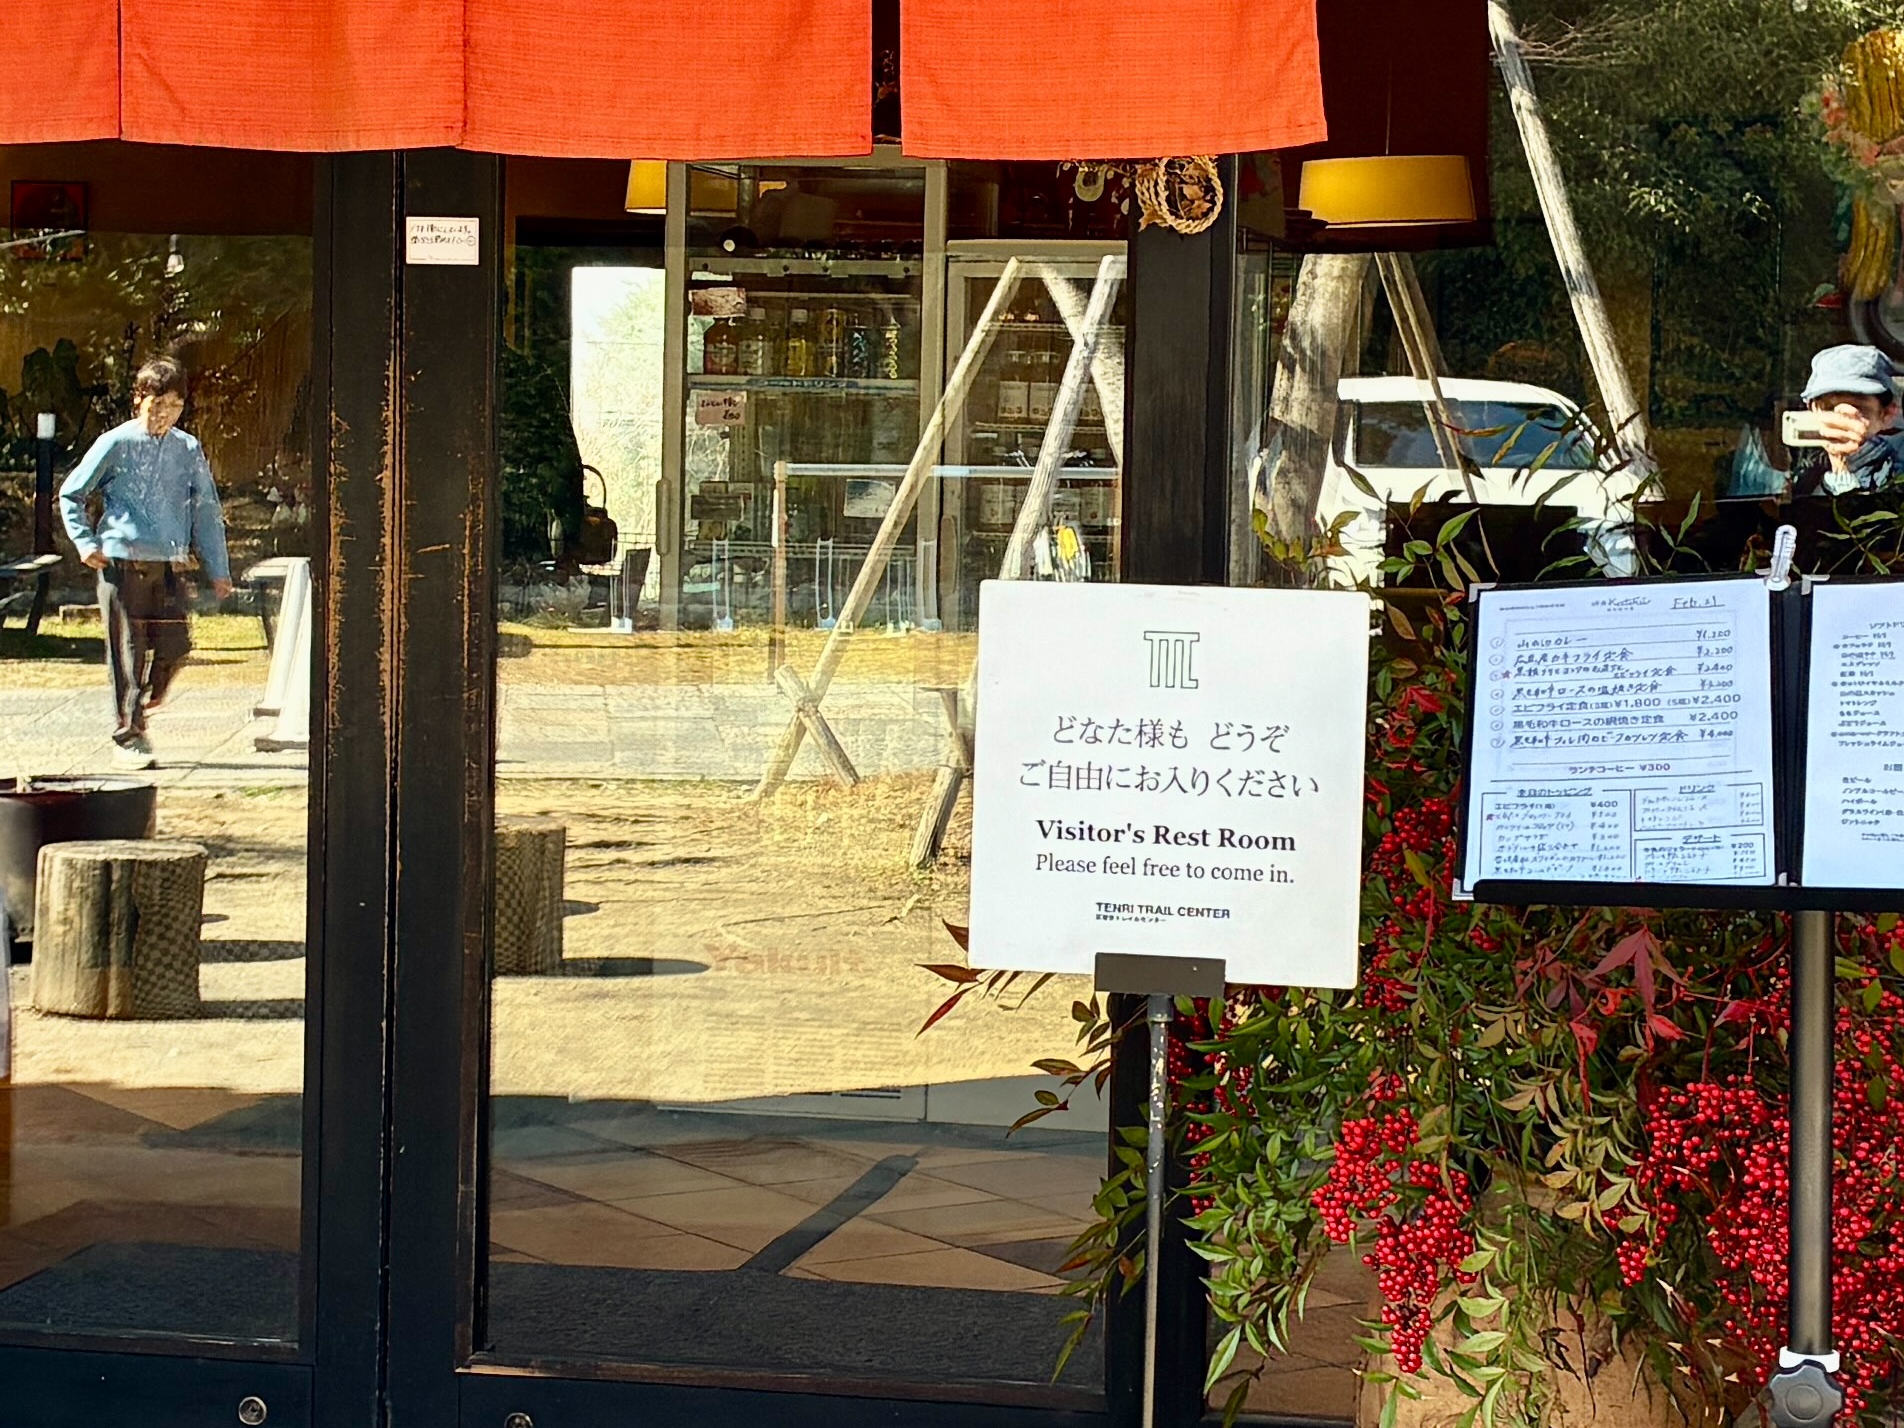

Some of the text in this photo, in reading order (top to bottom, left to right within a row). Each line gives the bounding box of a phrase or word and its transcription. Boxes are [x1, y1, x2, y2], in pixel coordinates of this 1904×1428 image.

[1052, 715, 1291, 754] どなた様も どうぞ
[1018, 759, 1320, 799] ご自由にお入りください
[1035, 819, 1297, 852] Visitor's Rest Room
[1035, 853, 1295, 884] Please feel free to come in.
[1095, 902, 1231, 920] TENRI TRAIL CENTER
